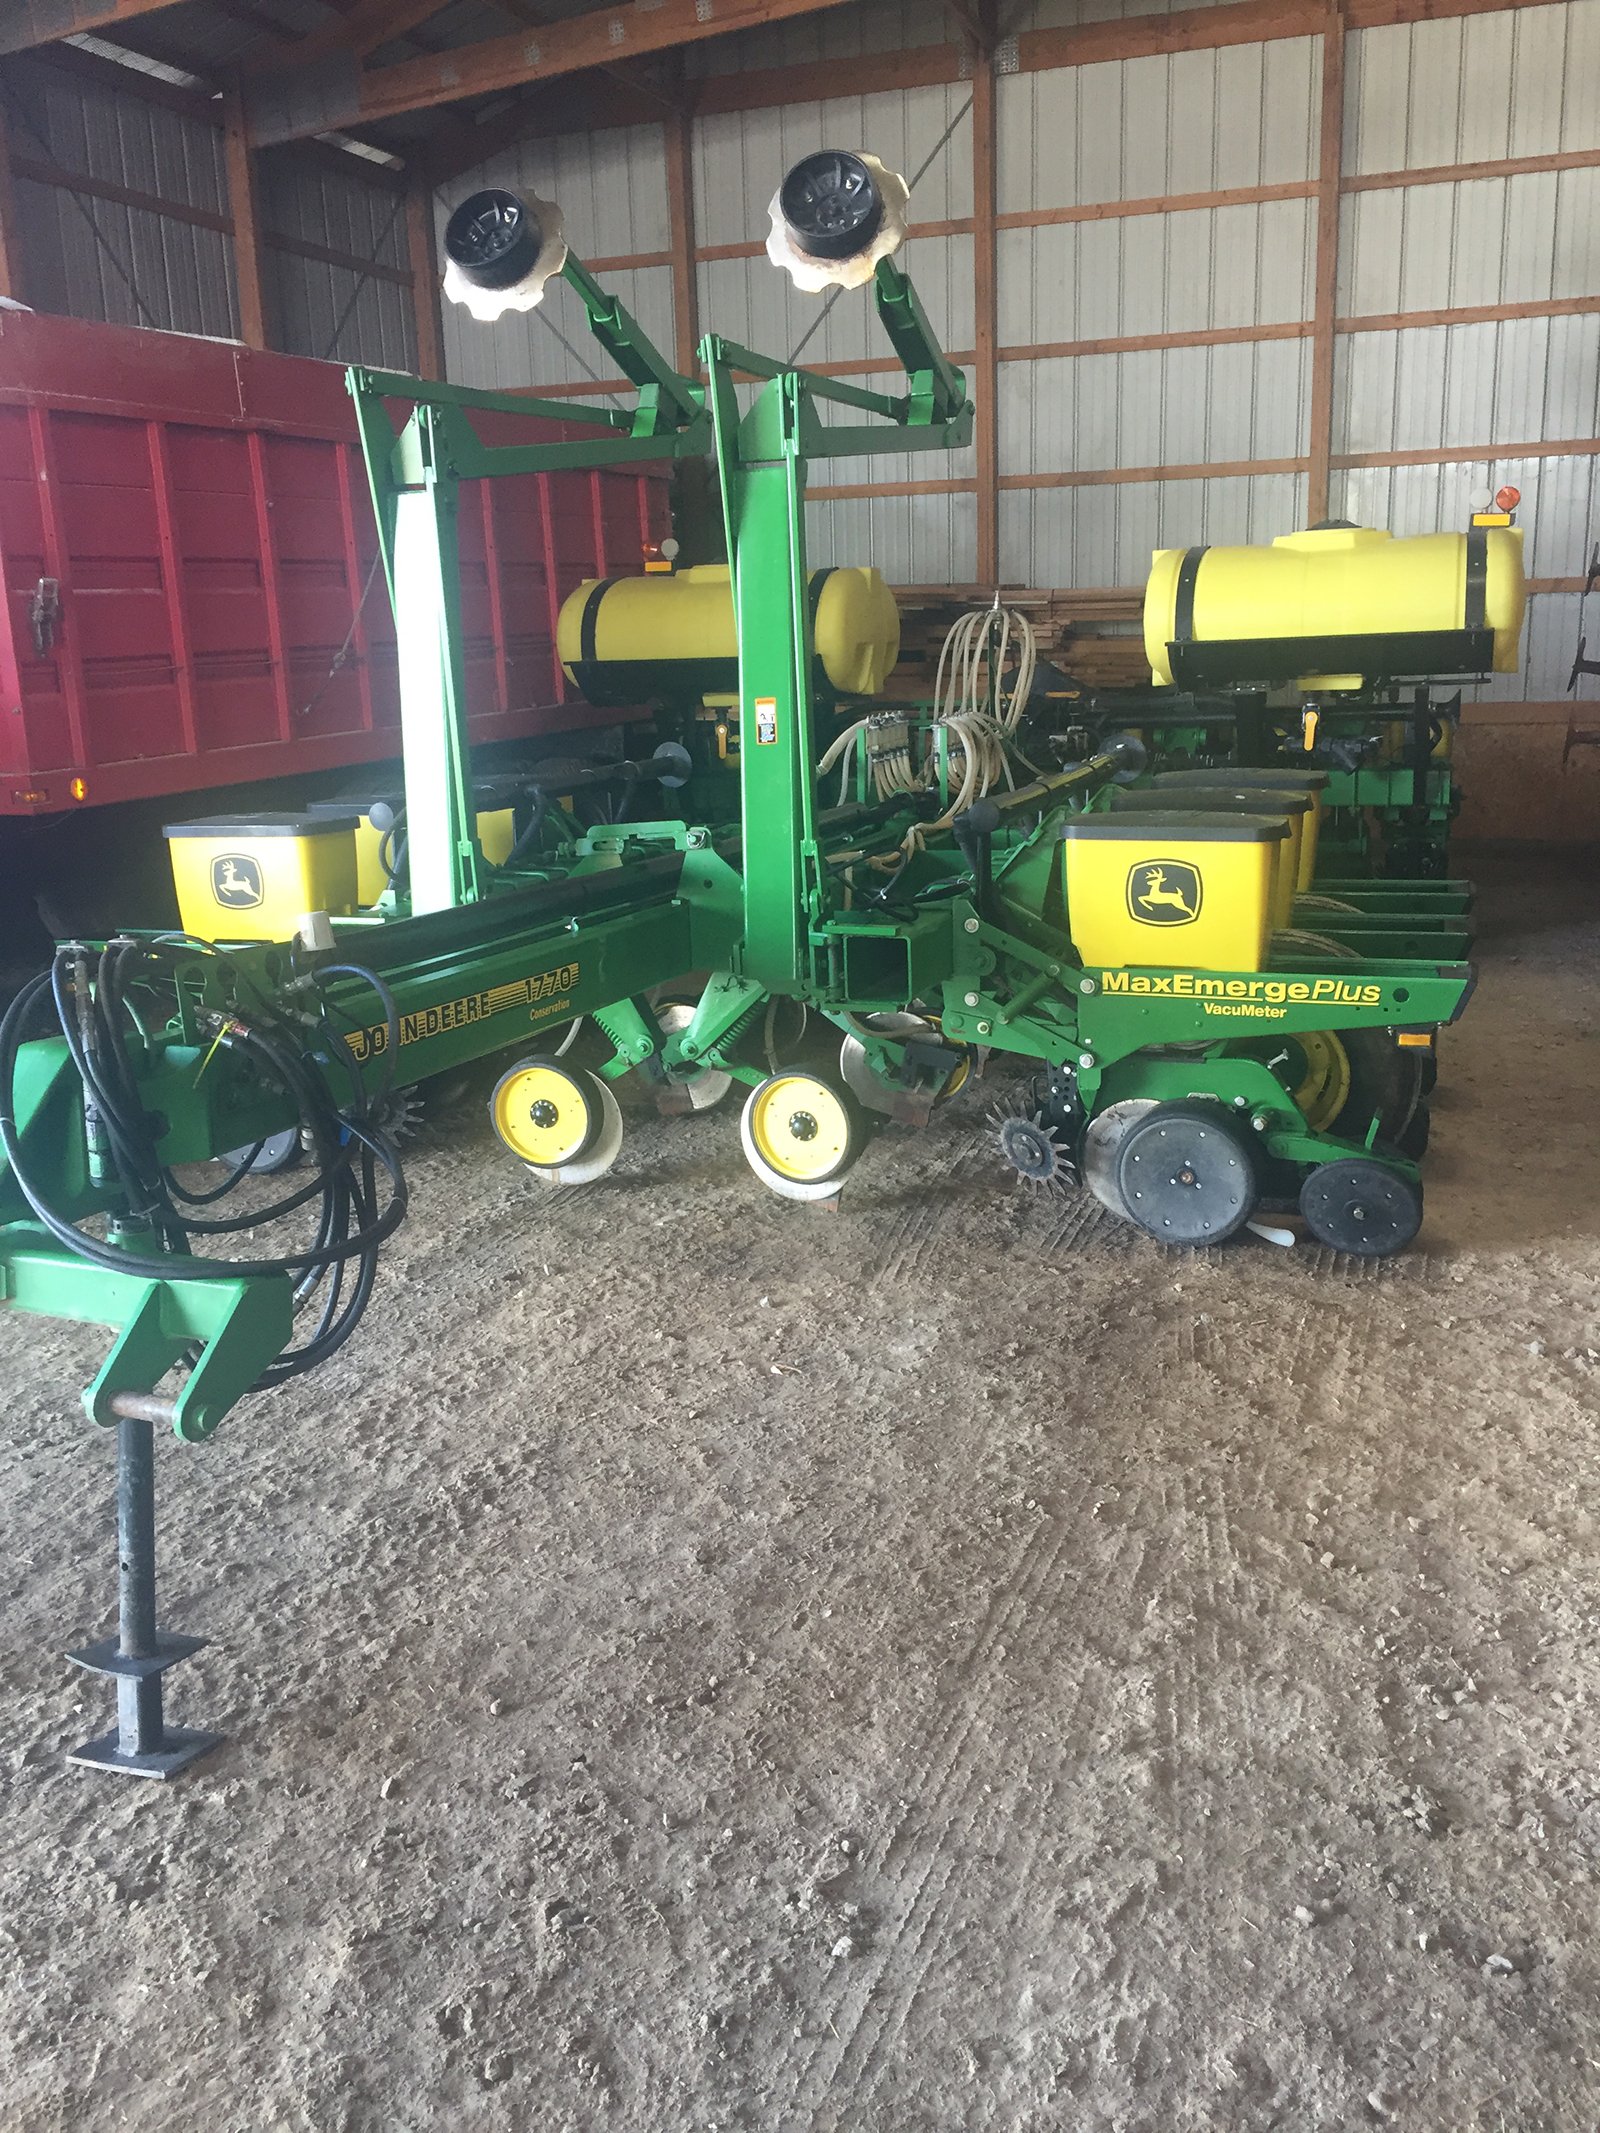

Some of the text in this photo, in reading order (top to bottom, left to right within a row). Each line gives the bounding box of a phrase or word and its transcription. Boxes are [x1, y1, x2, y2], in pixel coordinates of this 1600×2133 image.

[1102, 971, 1381, 1004] MaxEmergePlus
[354, 967, 572, 1060] JON DEERE 1770
[529, 1000, 570, 1021] Conservation
[1203, 1002, 1287, 1018] VacuMeter
